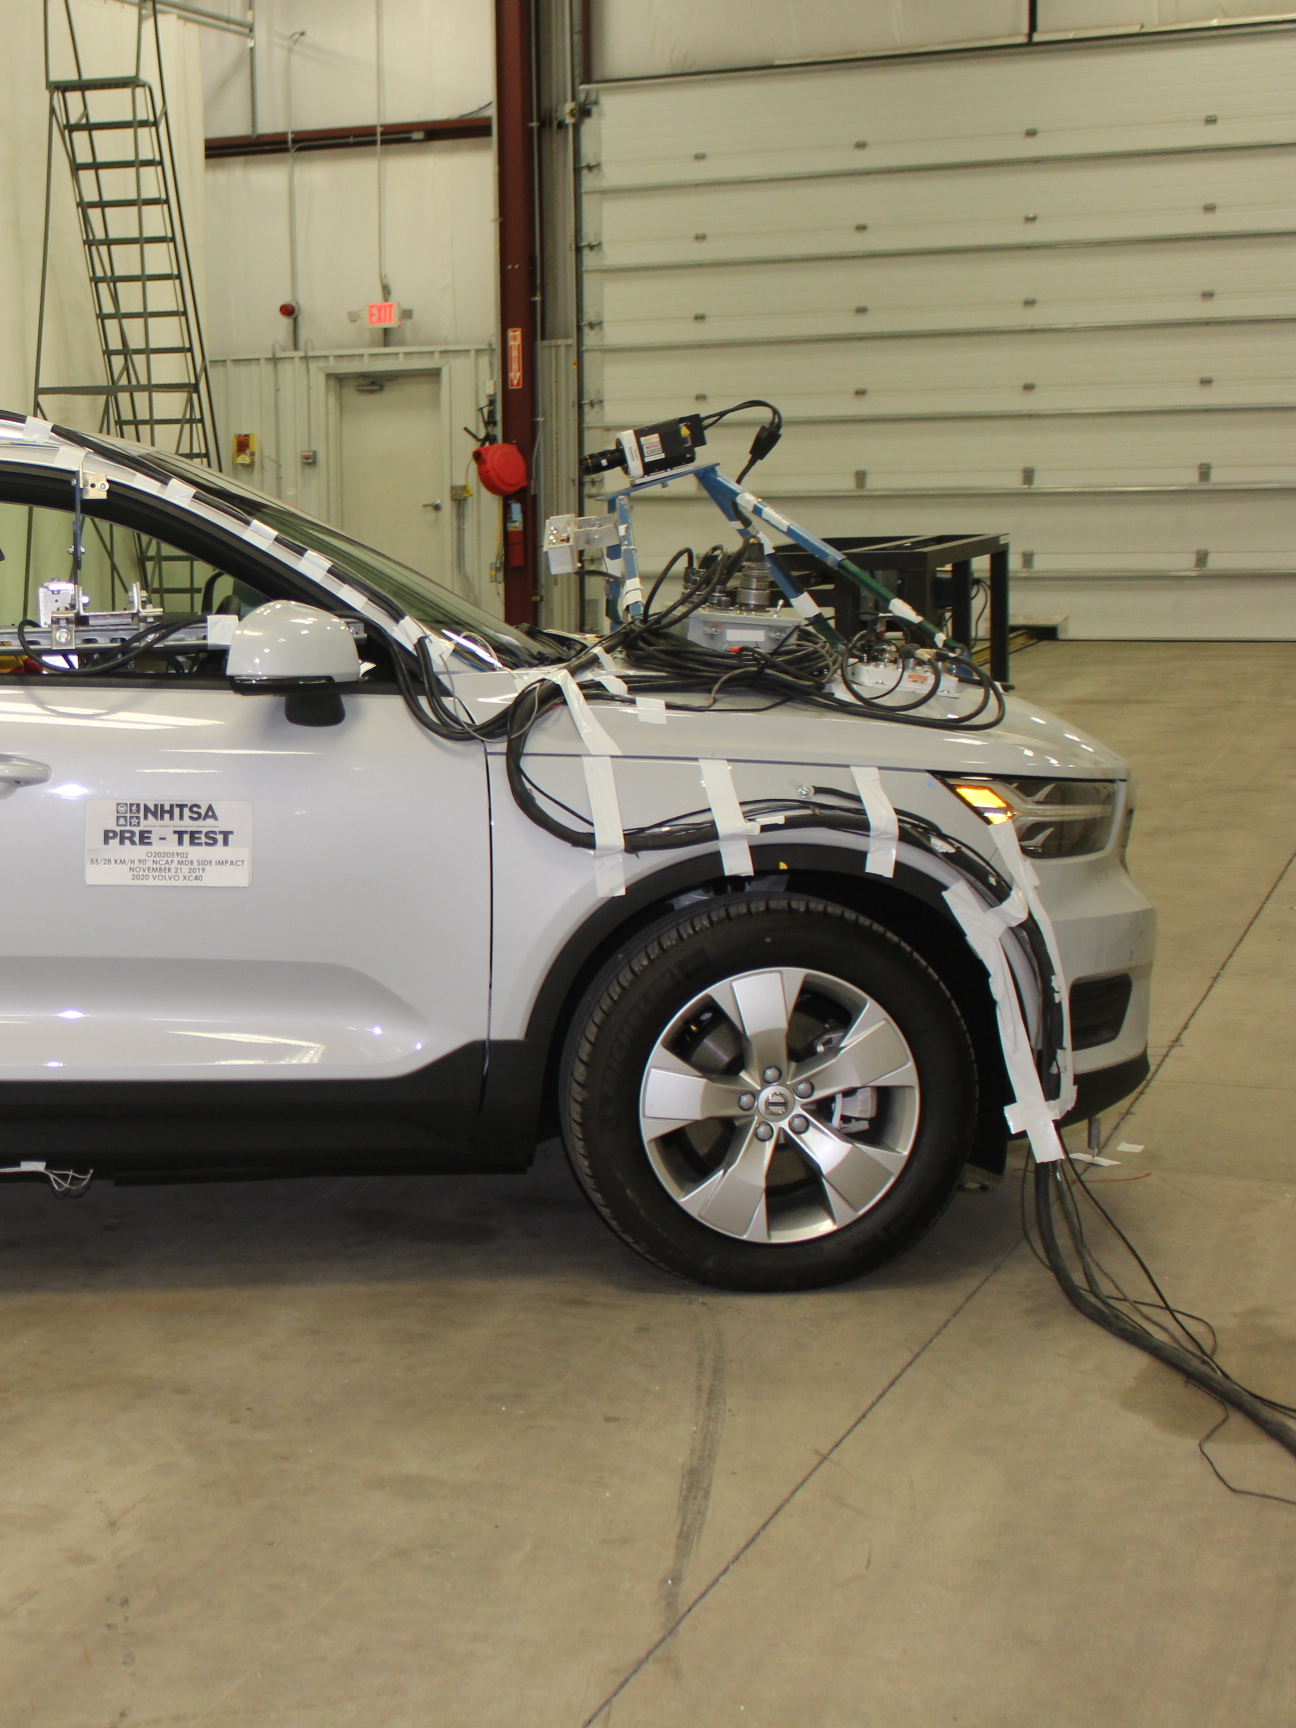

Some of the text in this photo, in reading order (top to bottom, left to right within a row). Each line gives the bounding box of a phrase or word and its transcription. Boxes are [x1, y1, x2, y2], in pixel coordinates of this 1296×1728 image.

[368, 303, 395, 325] EXIT
[143, 803, 219, 821] NHTSA
[103, 829, 153, 846] PRE
[173, 830, 234, 847] TEST
[90, 858, 112, 866] 55/28
[129, 866, 172, 874] NOVEMBER
